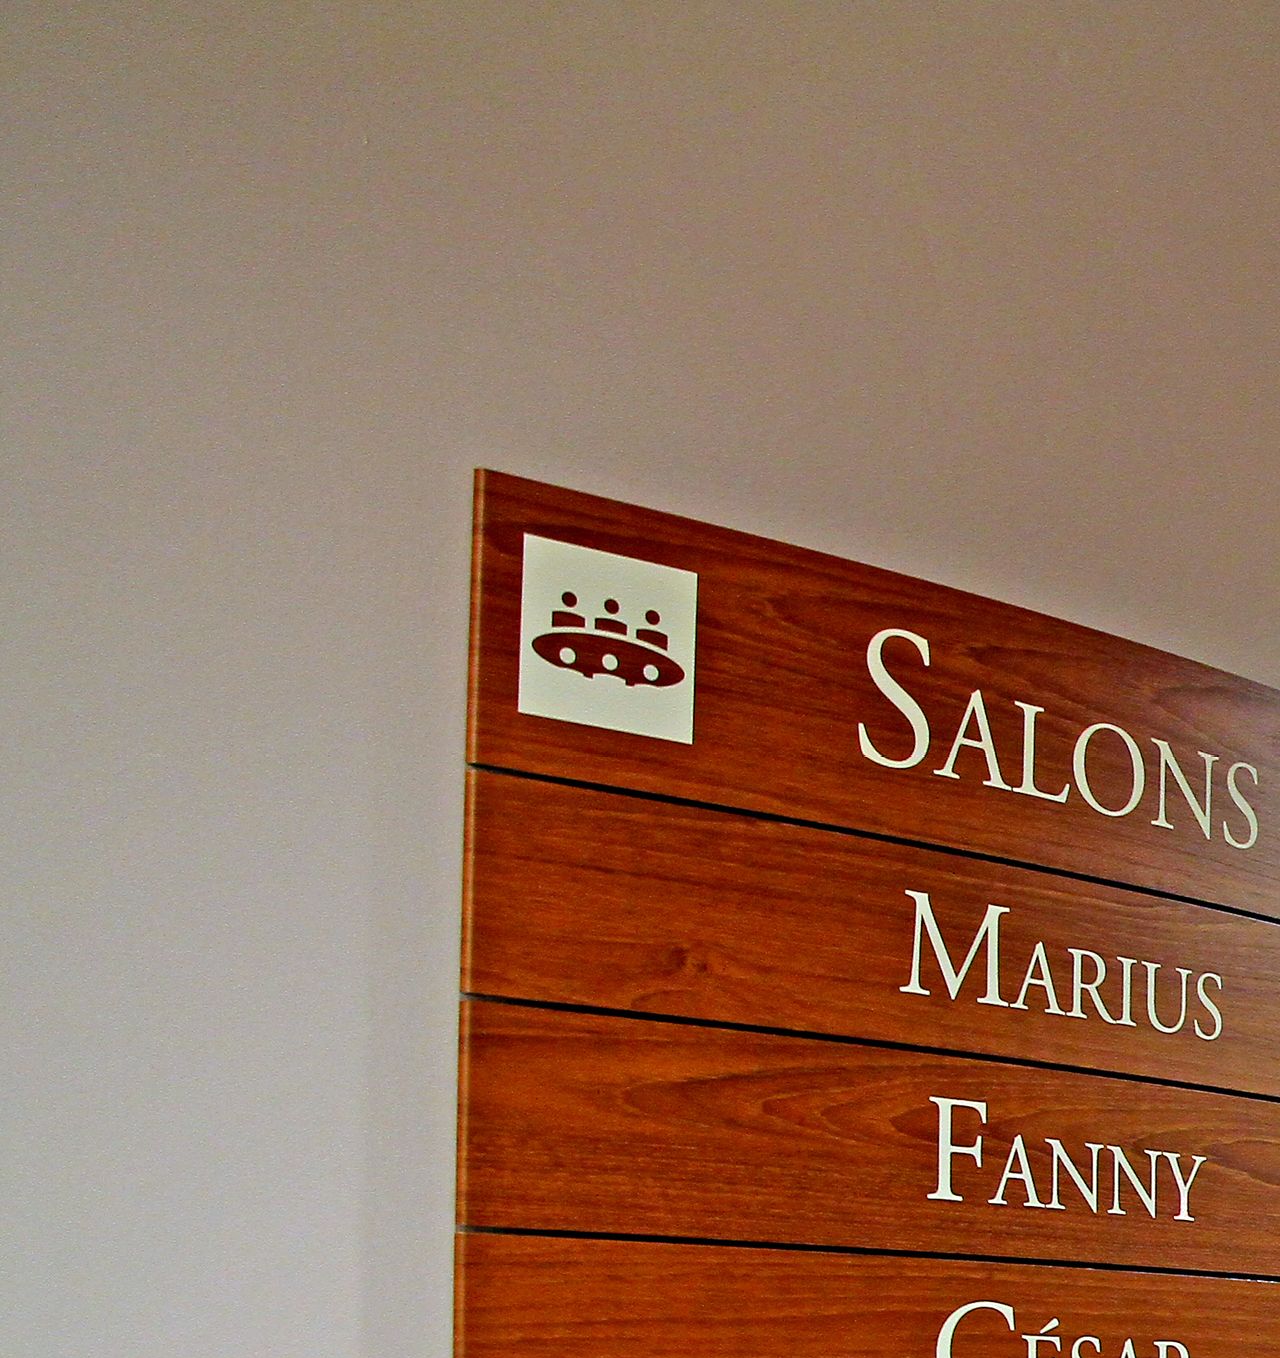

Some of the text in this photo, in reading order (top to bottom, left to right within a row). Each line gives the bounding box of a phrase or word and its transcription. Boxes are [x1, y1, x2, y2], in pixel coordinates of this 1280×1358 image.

[857, 628, 1261, 850] SALONS
[900, 889, 1224, 1042] MARIUS
[926, 1096, 1207, 1222] FANNY
